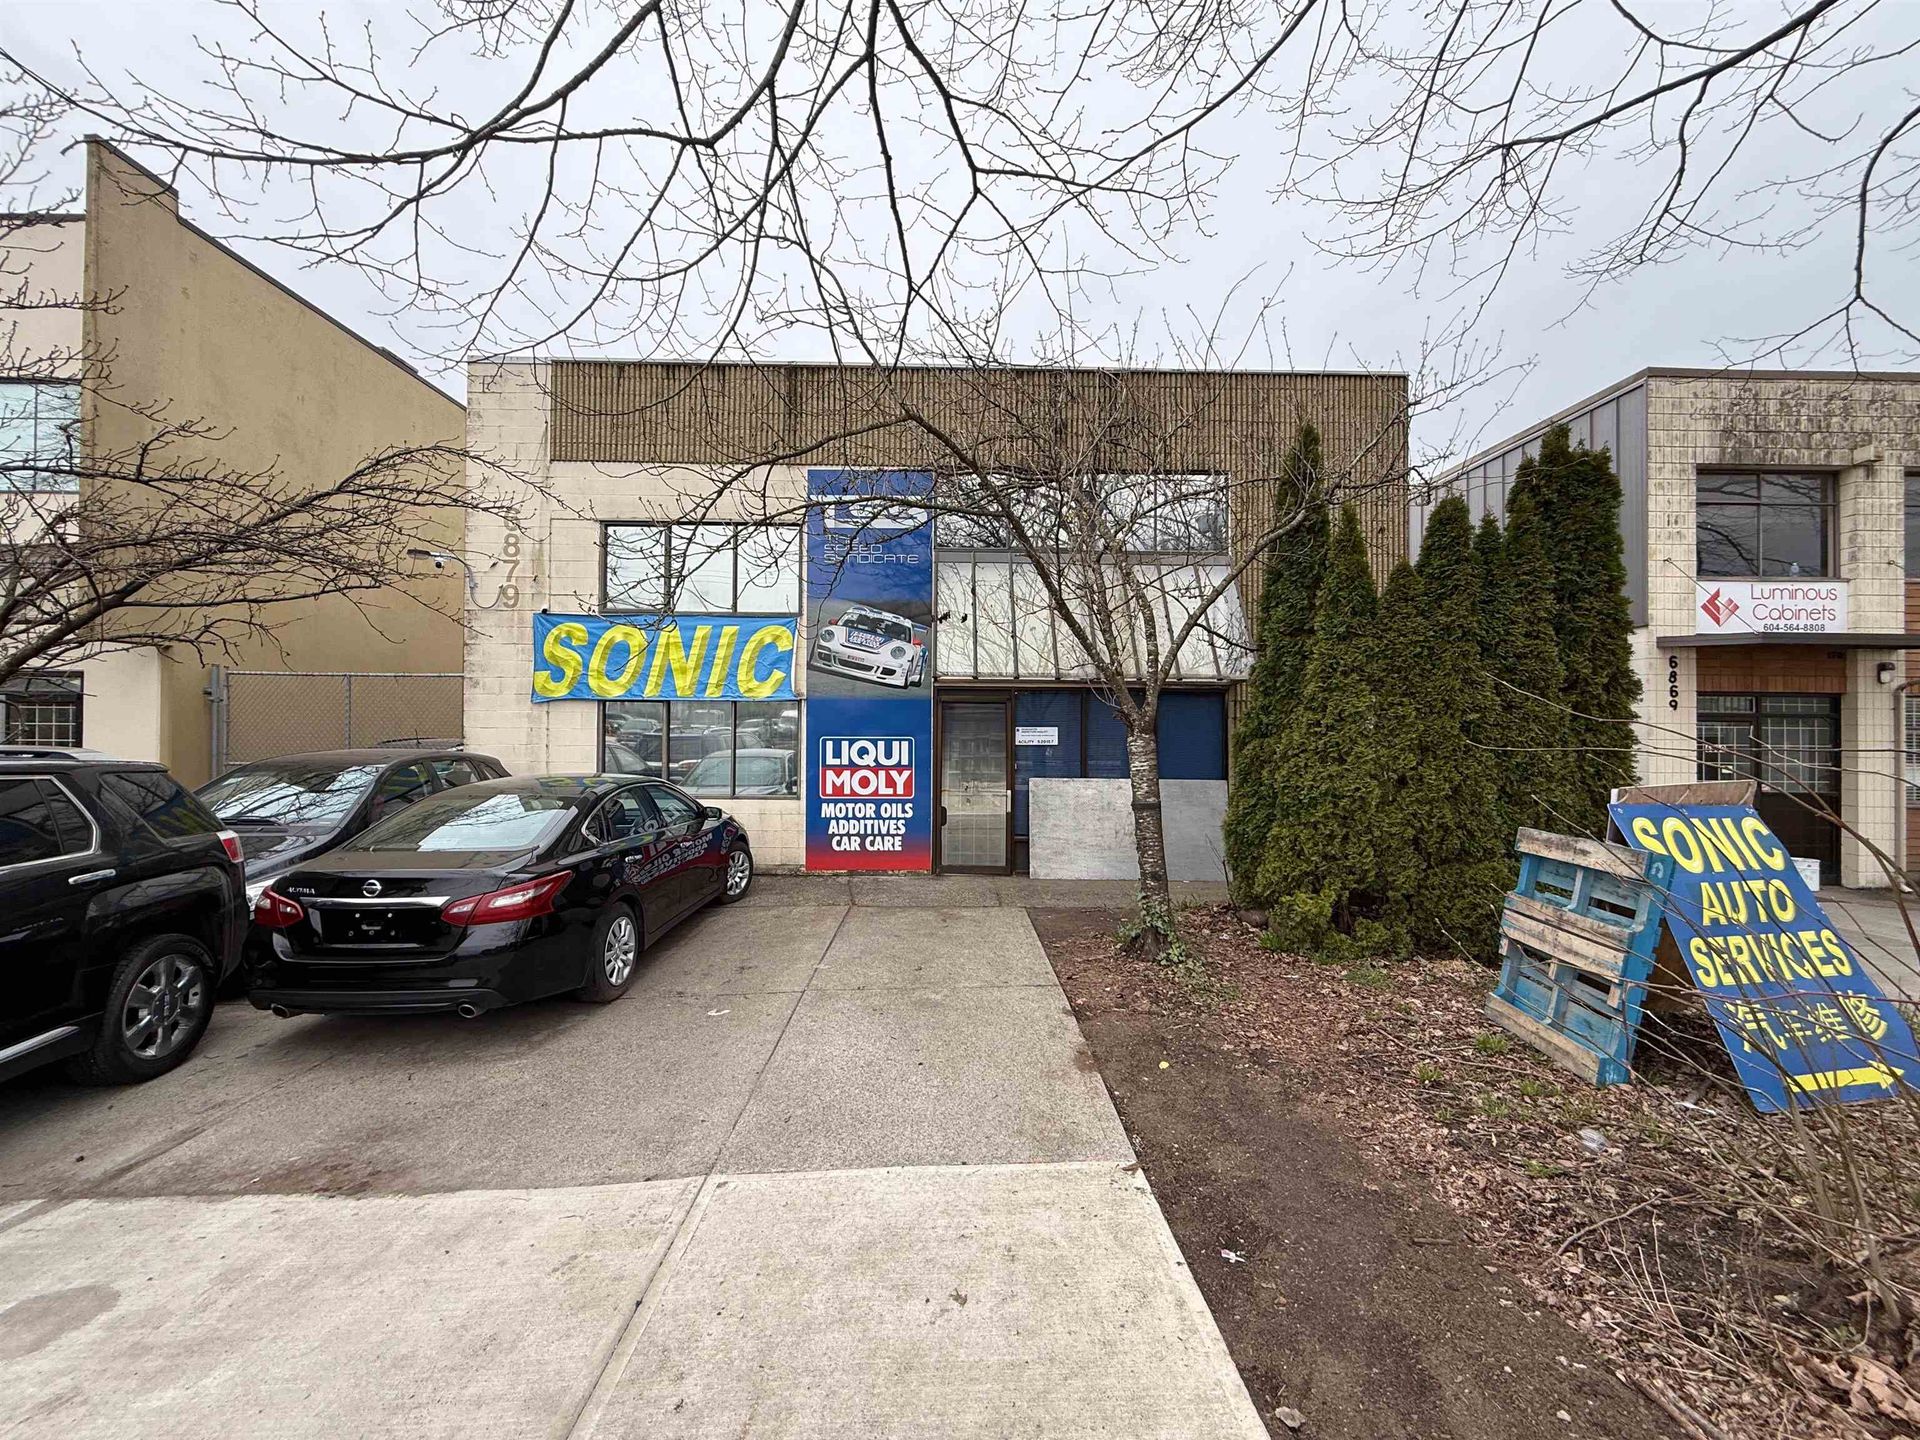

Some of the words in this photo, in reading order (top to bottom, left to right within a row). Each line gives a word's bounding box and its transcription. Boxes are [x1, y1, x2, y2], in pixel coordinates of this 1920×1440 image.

[1750, 584, 1838, 600] Luminous
[1752, 603, 1837, 621] Cabinets
[1763, 623, 1826, 632] 604-564-8808
[533, 622, 794, 698] SONIC
[1669, 655, 1678, 711] 6869
[825, 740, 909, 767] LIQUI
[825, 769, 912, 795] MOLY
[821, 803, 876, 818] MOTOR
[880, 803, 914, 818] OILS
[828, 820, 906, 834] ADDITIVES
[832, 836, 860, 851] CAR
[865, 836, 902, 851] CARE
[1632, 817, 1785, 873] SONIC
[1700, 879, 1796, 926] AUTO
[1690, 929, 1852, 988] SERVICES
